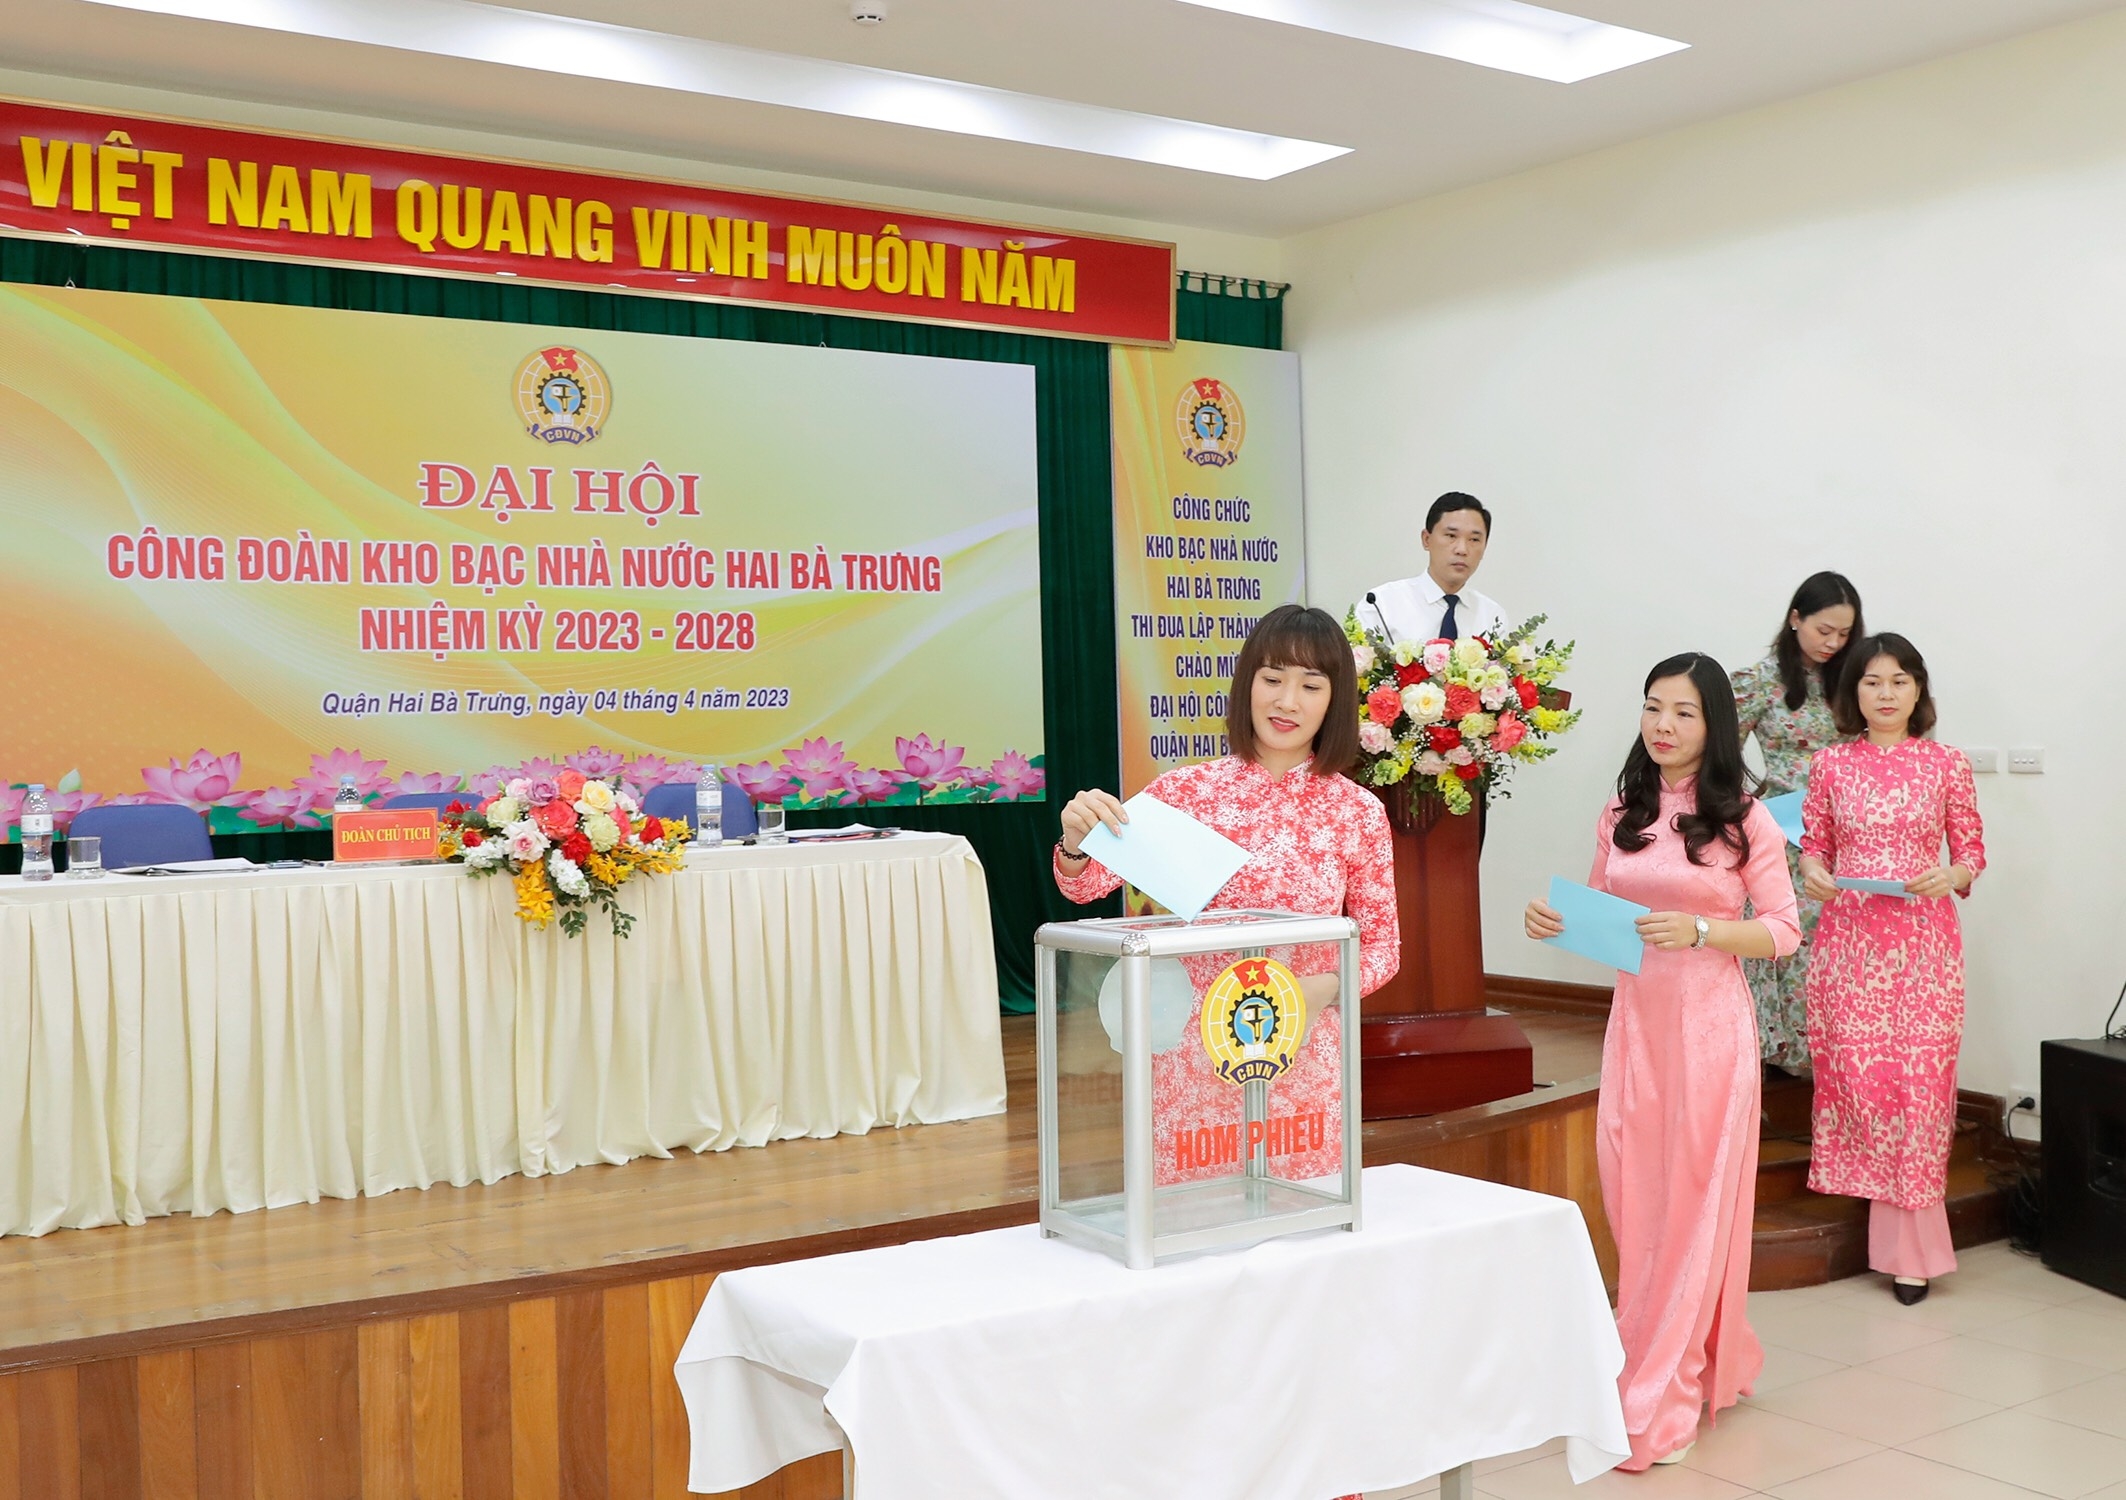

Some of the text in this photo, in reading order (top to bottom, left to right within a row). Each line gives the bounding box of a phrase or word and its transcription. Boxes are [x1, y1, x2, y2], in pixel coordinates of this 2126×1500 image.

[19, 130, 1076, 313] VIỆT NAM QUANG VINH MUÔN NĂM
[419, 461, 700, 526] ĐẠI HỘI
[1173, 493, 1250, 523] CÔNG CHỨC
[108, 527, 941, 594] CÔNG ĐOÀN KHO BẠC NHÀ NƯỚC HAI BÀ TRƯNG
[1146, 535, 1278, 564] KHO BẠC NHÀ NƯỚC
[1167, 573, 1261, 600] HAI BÀ TRƯNG
[361, 601, 485, 659] NHIỆM
[499, 602, 543, 650] KỲ
[555, 612, 640, 650] 2023
[675, 612, 755, 650] 2028
[1131, 612, 1261, 643] THI ĐUA LẬP THÀN
[1176, 651, 1212, 677] CHÀO
[323, 688, 788, 717] Quận Hai Bà Trưng, ngày 04 tháng 4 năm 2023
[1150, 695, 1173, 722] ĐẠI
[1178, 690, 1201, 722] HỘI
[1150, 730, 1188, 762] QUẬN
[1193, 735, 1215, 757] HAI
[341, 824, 431, 843] ĐOÀN CHỦ TỊCH
[1236, 1062, 1274, 1081] CĐVN
[1175, 1101, 1325, 1171] HÒM PHIẾU
